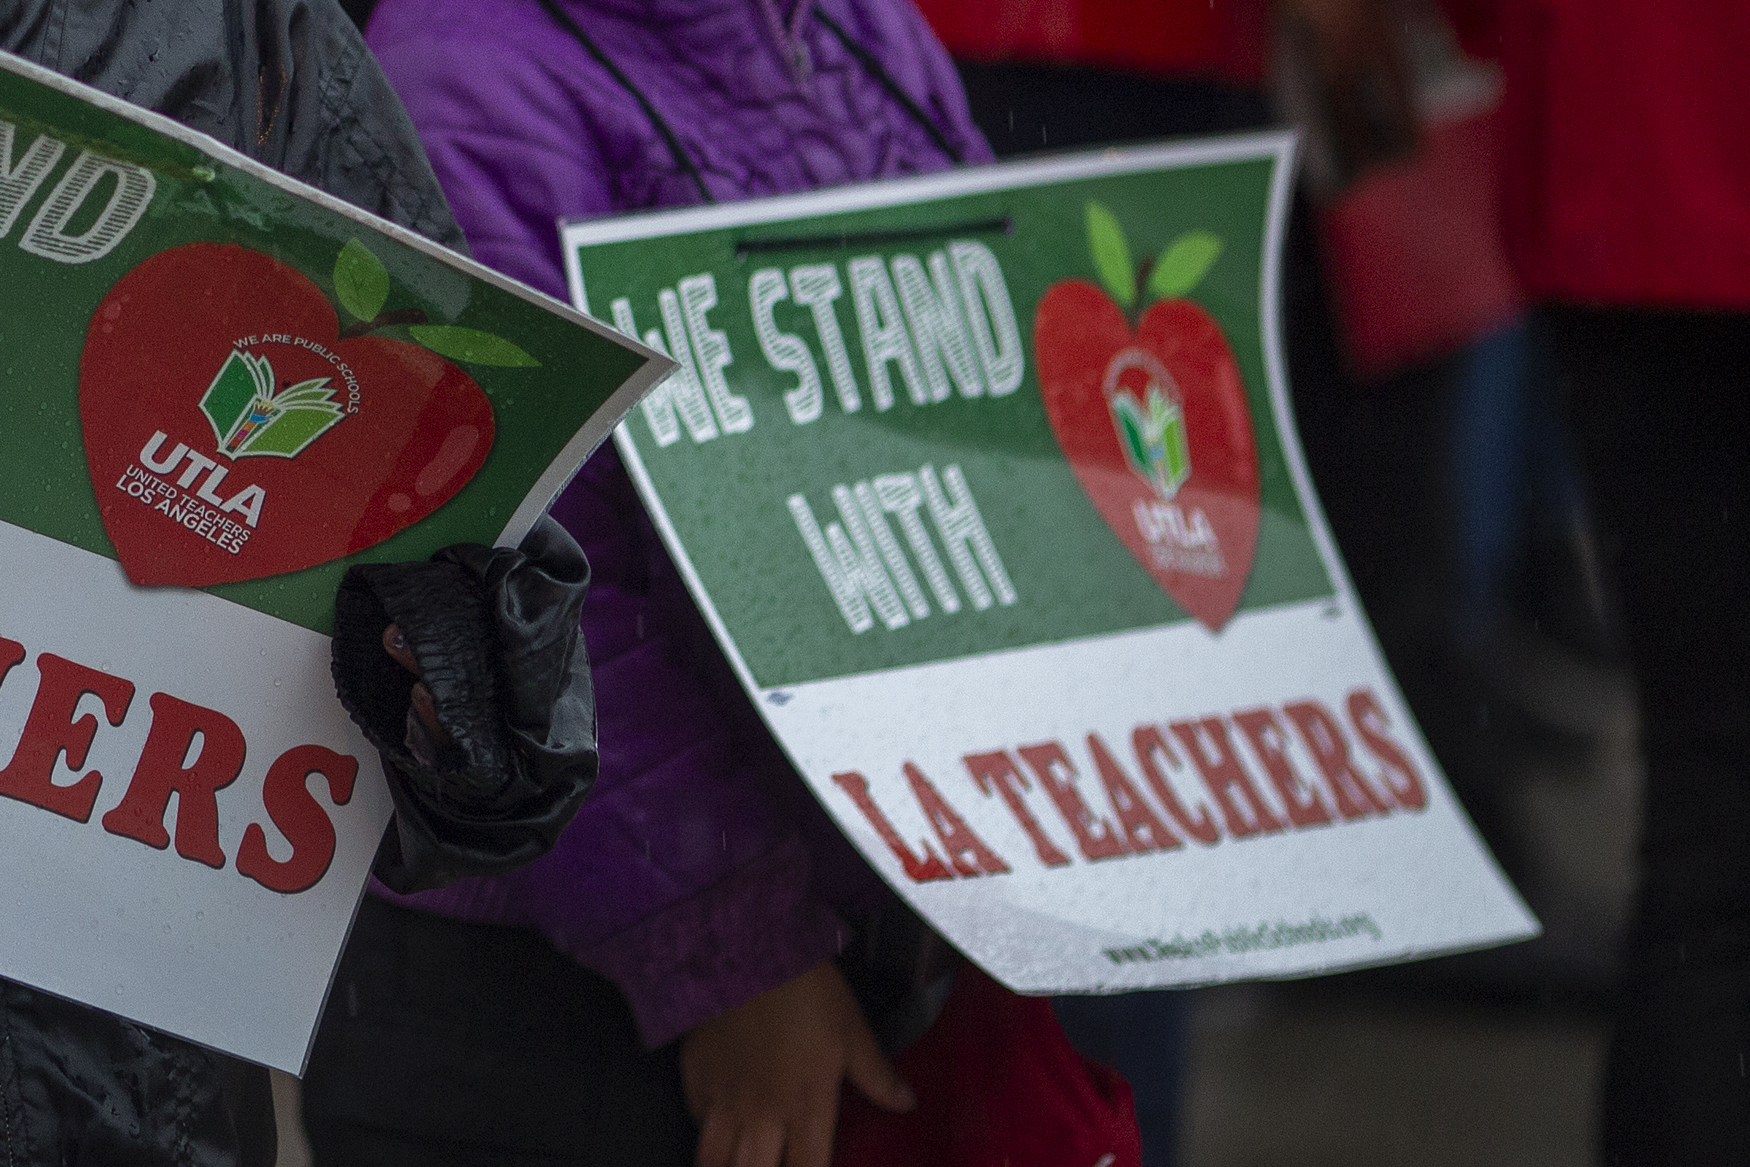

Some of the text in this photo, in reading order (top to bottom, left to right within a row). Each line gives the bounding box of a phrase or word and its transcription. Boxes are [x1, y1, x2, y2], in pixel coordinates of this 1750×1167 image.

[233, 333, 361, 414] WE ARE PUBLIC SCHOOLS
[748, 239, 1025, 424] STAND
[115, 474, 244, 555] LOS ANGELES
[126, 464, 251, 542] UNITED TEACHERS
[139, 430, 266, 528] UTLA
[787, 463, 1018, 634] WITH
[830, 686, 1431, 883] LA TEACHERS
